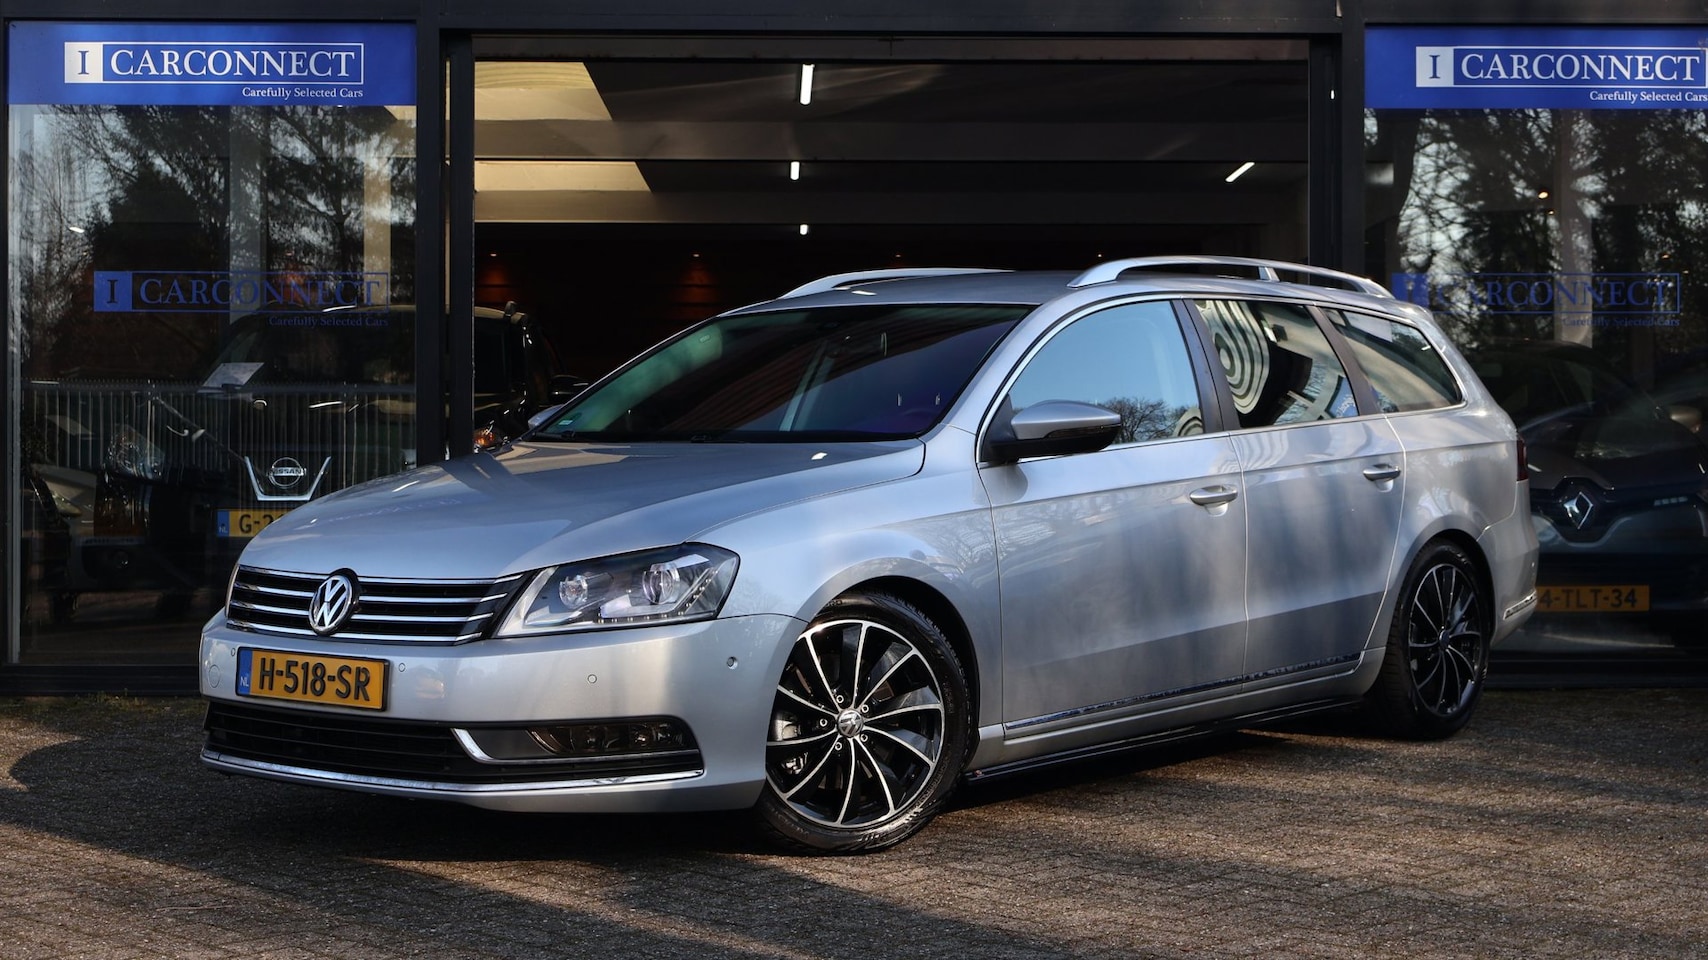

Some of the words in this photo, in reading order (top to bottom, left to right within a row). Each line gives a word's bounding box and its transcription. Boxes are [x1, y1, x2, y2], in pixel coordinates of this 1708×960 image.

[110, 49, 355, 77] CARCONNECT
[1461, 53, 1699, 81] CARCONNECT
[242, 86, 291, 99] Carefully
[293, 87, 337, 98] Selected
[339, 88, 363, 98] Cars
[1589, 90, 1638, 104] Carefully
[1640, 91, 1682, 102] Selected
[1684, 92, 1708, 102] Cars
[139, 278, 380, 306] CARCONNECT
[268, 316, 317, 328] Carefully
[320, 316, 362, 327] Selected
[365, 317, 389, 327] Cars
[271, 468, 302, 476] NISSAN
[1539, 589, 1637, 609] 4-TLT-34
[240, 676, 249, 688] NL
[259, 657, 370, 701] H-518-SR
